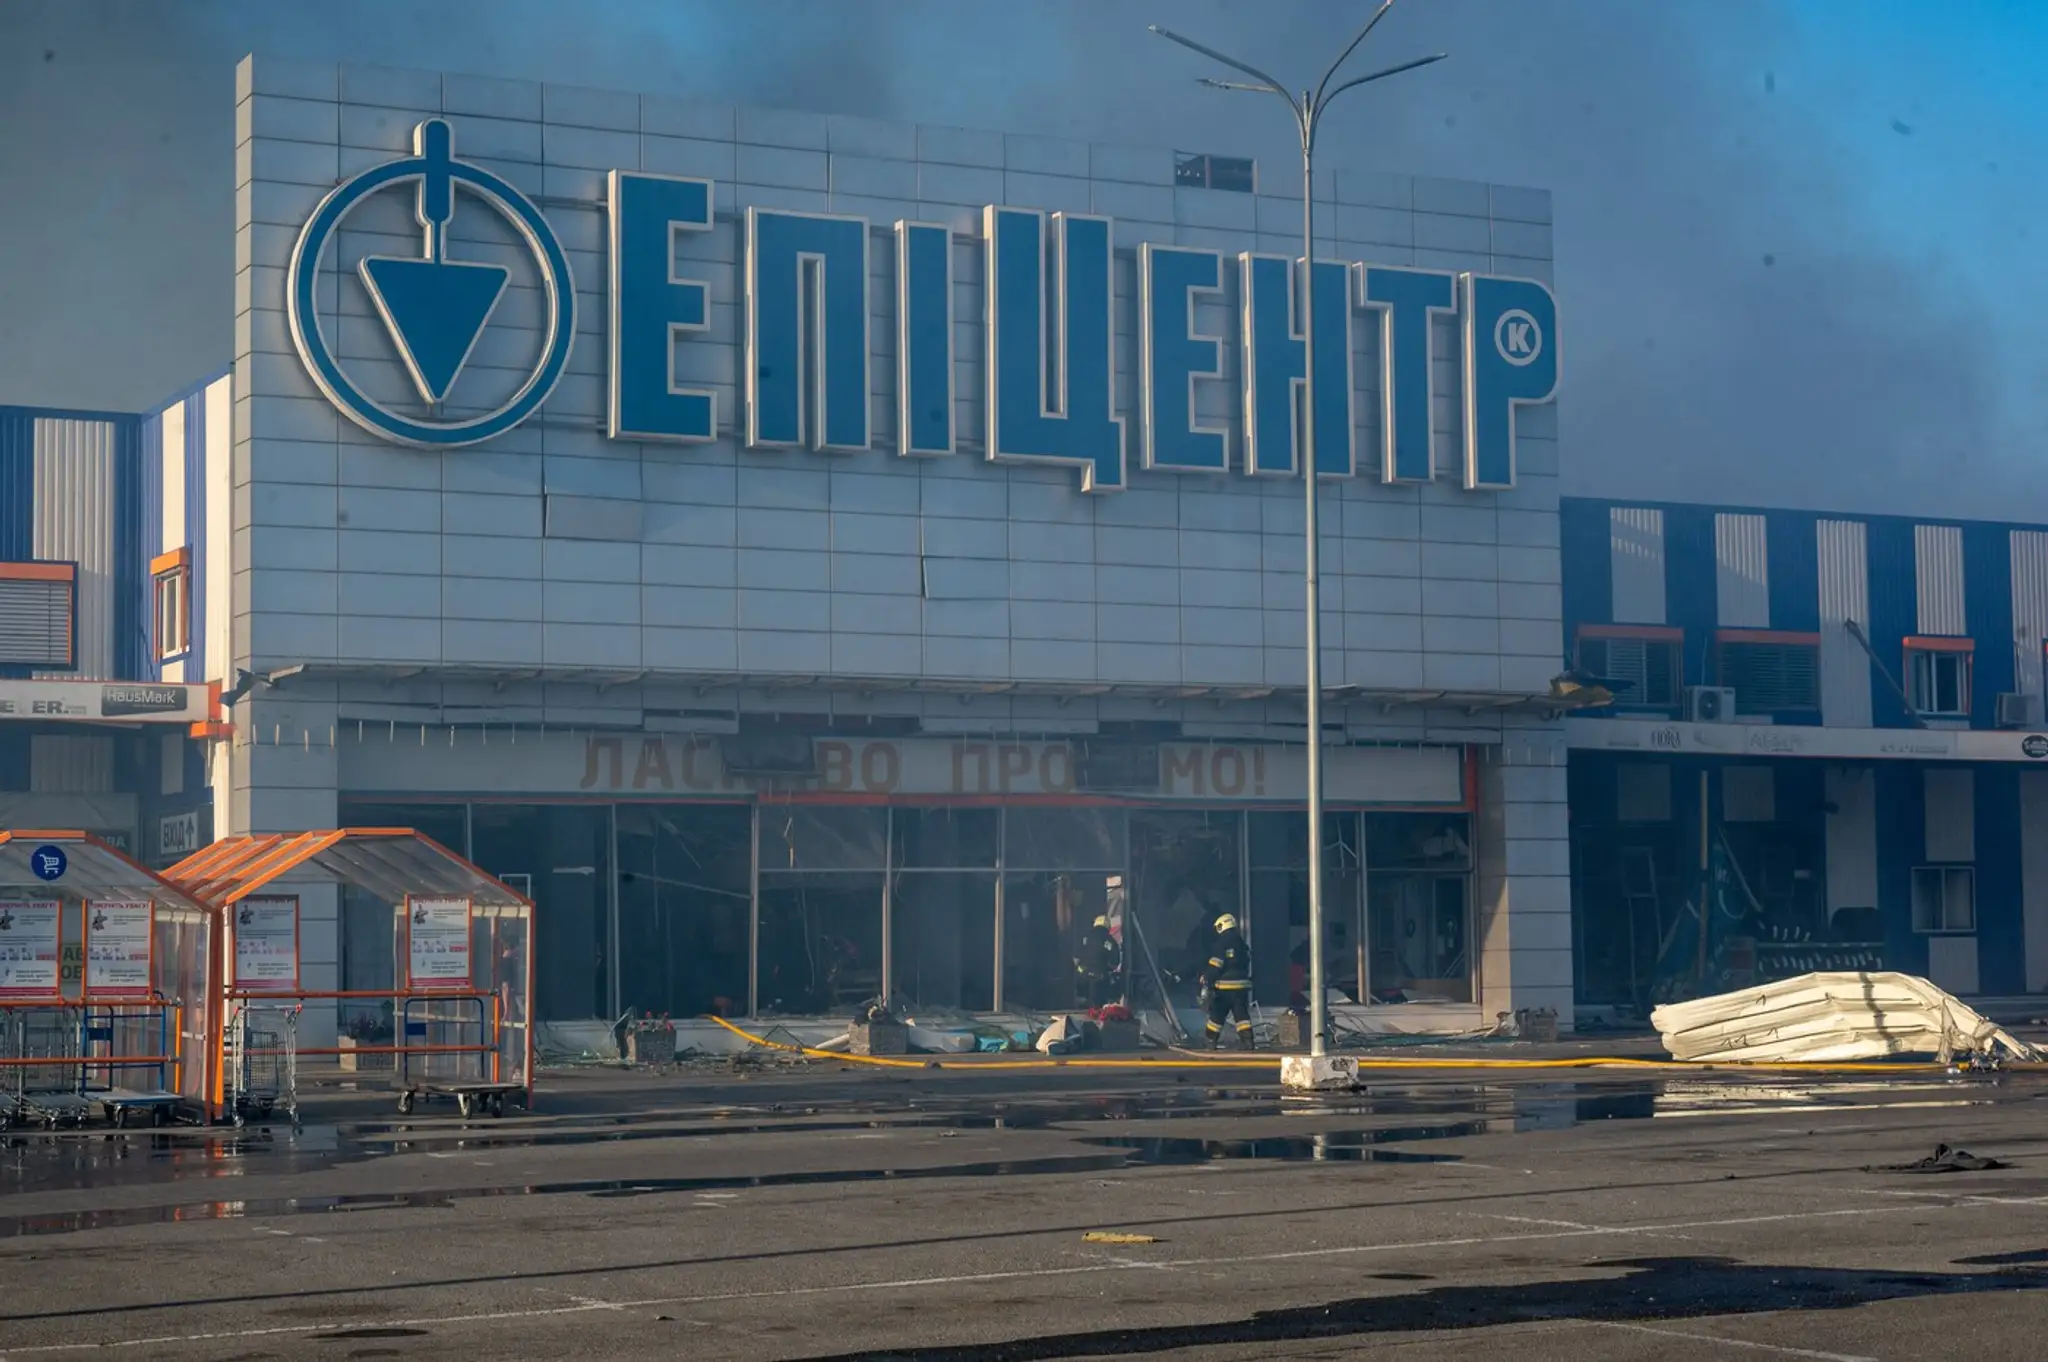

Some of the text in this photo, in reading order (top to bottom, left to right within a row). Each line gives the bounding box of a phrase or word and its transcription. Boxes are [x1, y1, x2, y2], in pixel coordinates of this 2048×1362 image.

[608, 169, 1560, 491] ЕПІЦЕНТР
[106, 688, 176, 704] HausMark
[580, 737, 1266, 796] ЛАСВО ПРОМО!
[163, 820, 186, 852] ВХІД
